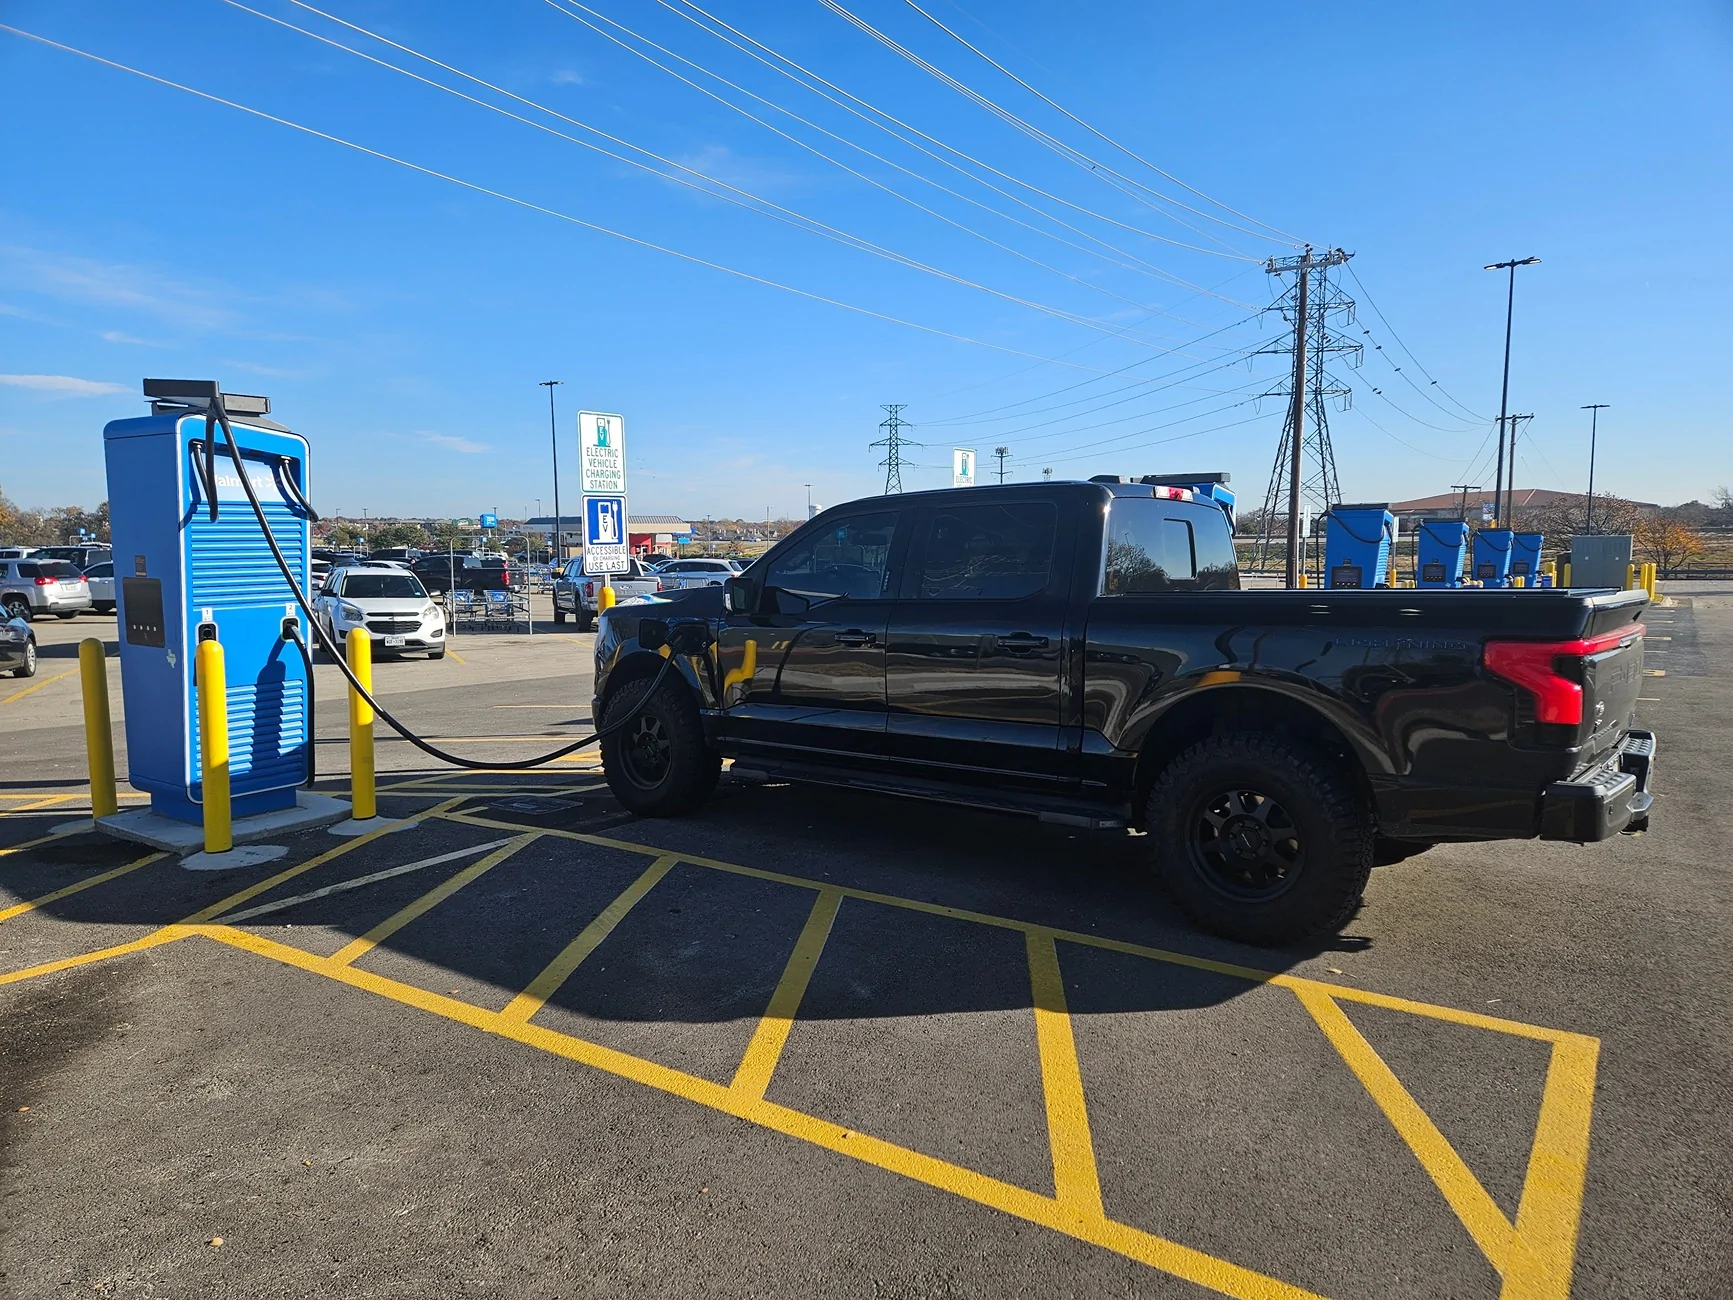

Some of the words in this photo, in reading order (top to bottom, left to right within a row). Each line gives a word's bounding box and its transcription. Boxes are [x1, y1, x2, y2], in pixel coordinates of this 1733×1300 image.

[586, 447, 619, 458] ELECTRIC
[588, 458, 618, 469] VEHICLE
[585, 469, 621, 480] CHARGING
[956, 475, 972, 484] ELECTRIC
[590, 480, 618, 490] STATION
[586, 546, 626, 556] ACCESSIBLE
[588, 562, 604, 571] USE
[606, 561, 625, 570] LAST
